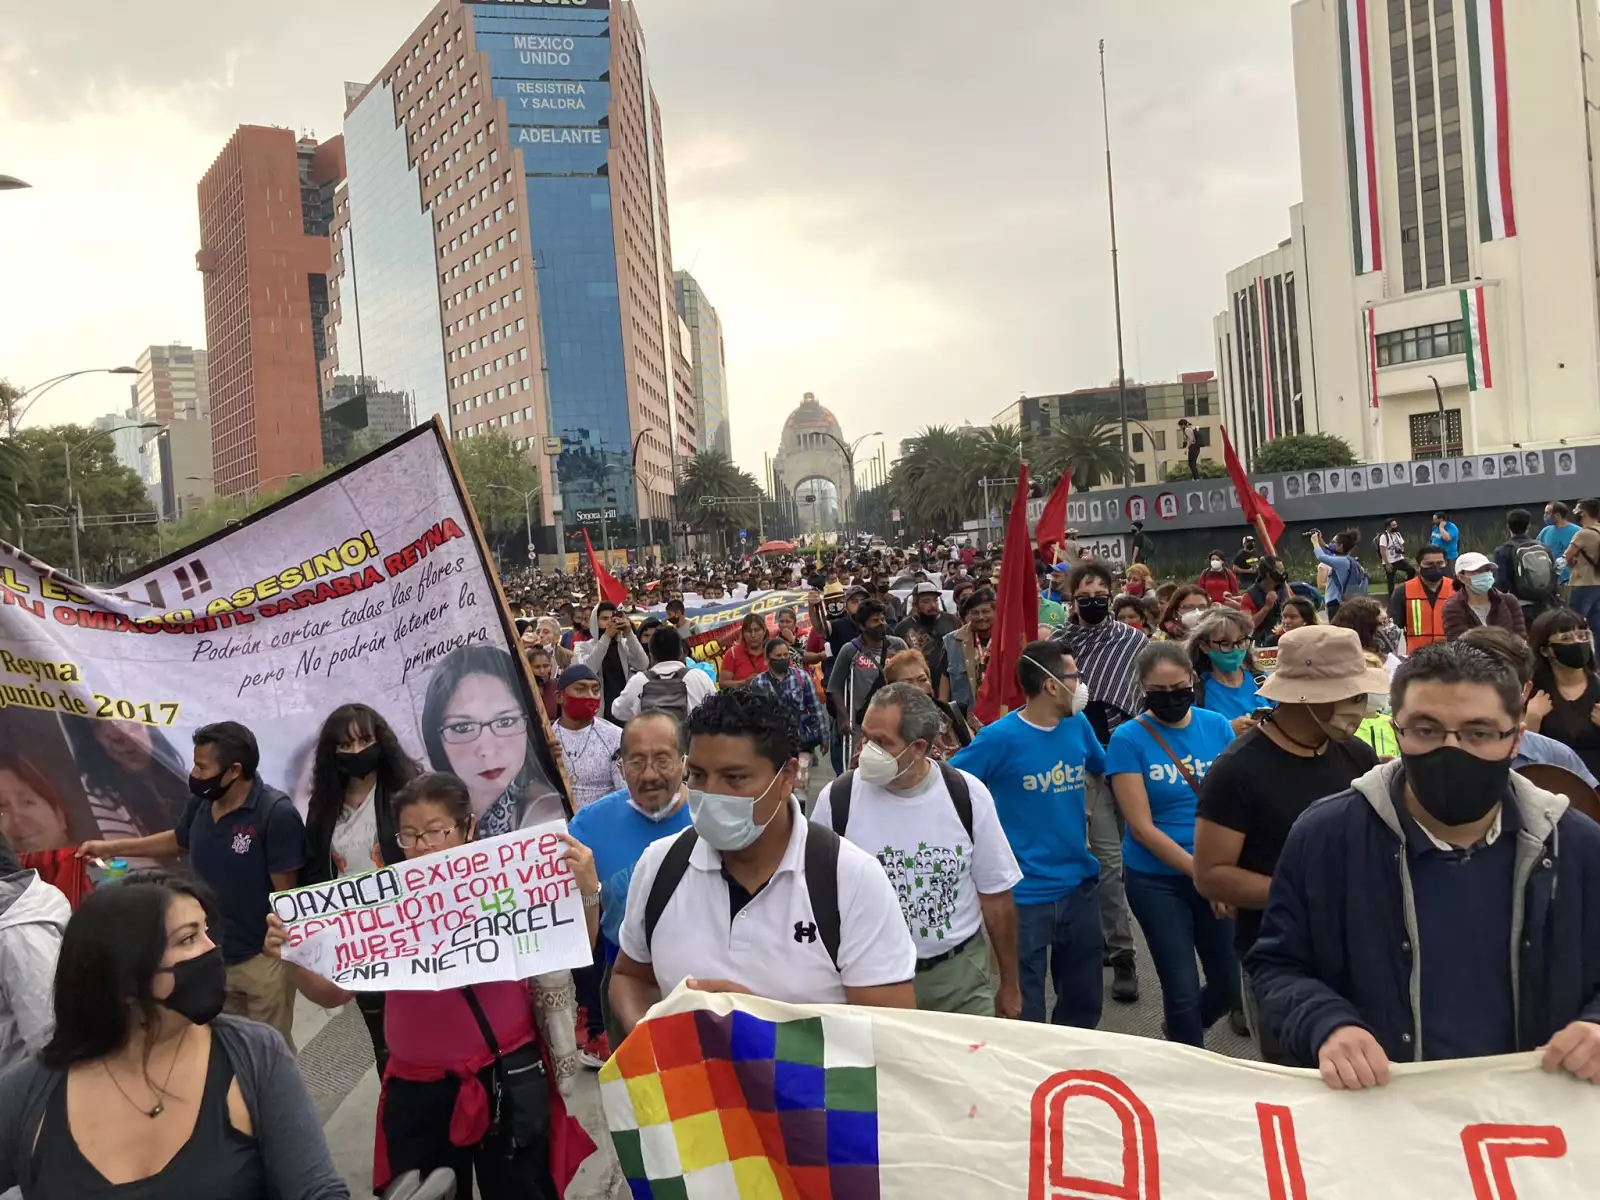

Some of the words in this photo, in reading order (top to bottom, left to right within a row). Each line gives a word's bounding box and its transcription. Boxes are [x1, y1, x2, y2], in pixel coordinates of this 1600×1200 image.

[514, 35, 574, 51] MÉXICO
[520, 52, 570, 66] UNIDO
[517, 81, 585, 95] RESISTIRÁ
[520, 98, 528, 109] Y
[532, 97, 585, 110] SALDRÁ
[519, 129, 601, 144] ADELANTE
[576, 510, 601, 521] Sonora
[206, 530, 380, 617] ASESINO!
[259, 565, 386, 618] SARABIA
[384, 517, 465, 577] REYNA
[192, 635, 260, 662] Podrán
[271, 618, 331, 648] cortar
[341, 599, 384, 628] todas
[392, 585, 412, 608] las
[417, 556, 465, 603] flores
[238, 667, 284, 697] pero
[295, 649, 321, 678] No
[328, 632, 387, 677] podrán
[394, 603, 450, 643] detener
[459, 582, 477, 607] la
[402, 626, 489, 684] primavera
[1, 650, 79, 684] Reyna
[59, 690, 89, 715] de
[94, 694, 180, 726] 2017
[274, 870, 400, 923] OAXACA
[405, 854, 489, 892] exige
[498, 833, 558, 868] pre
[453, 872, 509, 904] con
[516, 855, 572, 885] vida
[334, 905, 477, 961] nuestros
[480, 887, 517, 914] 43
[333, 961, 390, 983] EÑA
[411, 938, 500, 975] NIETO
